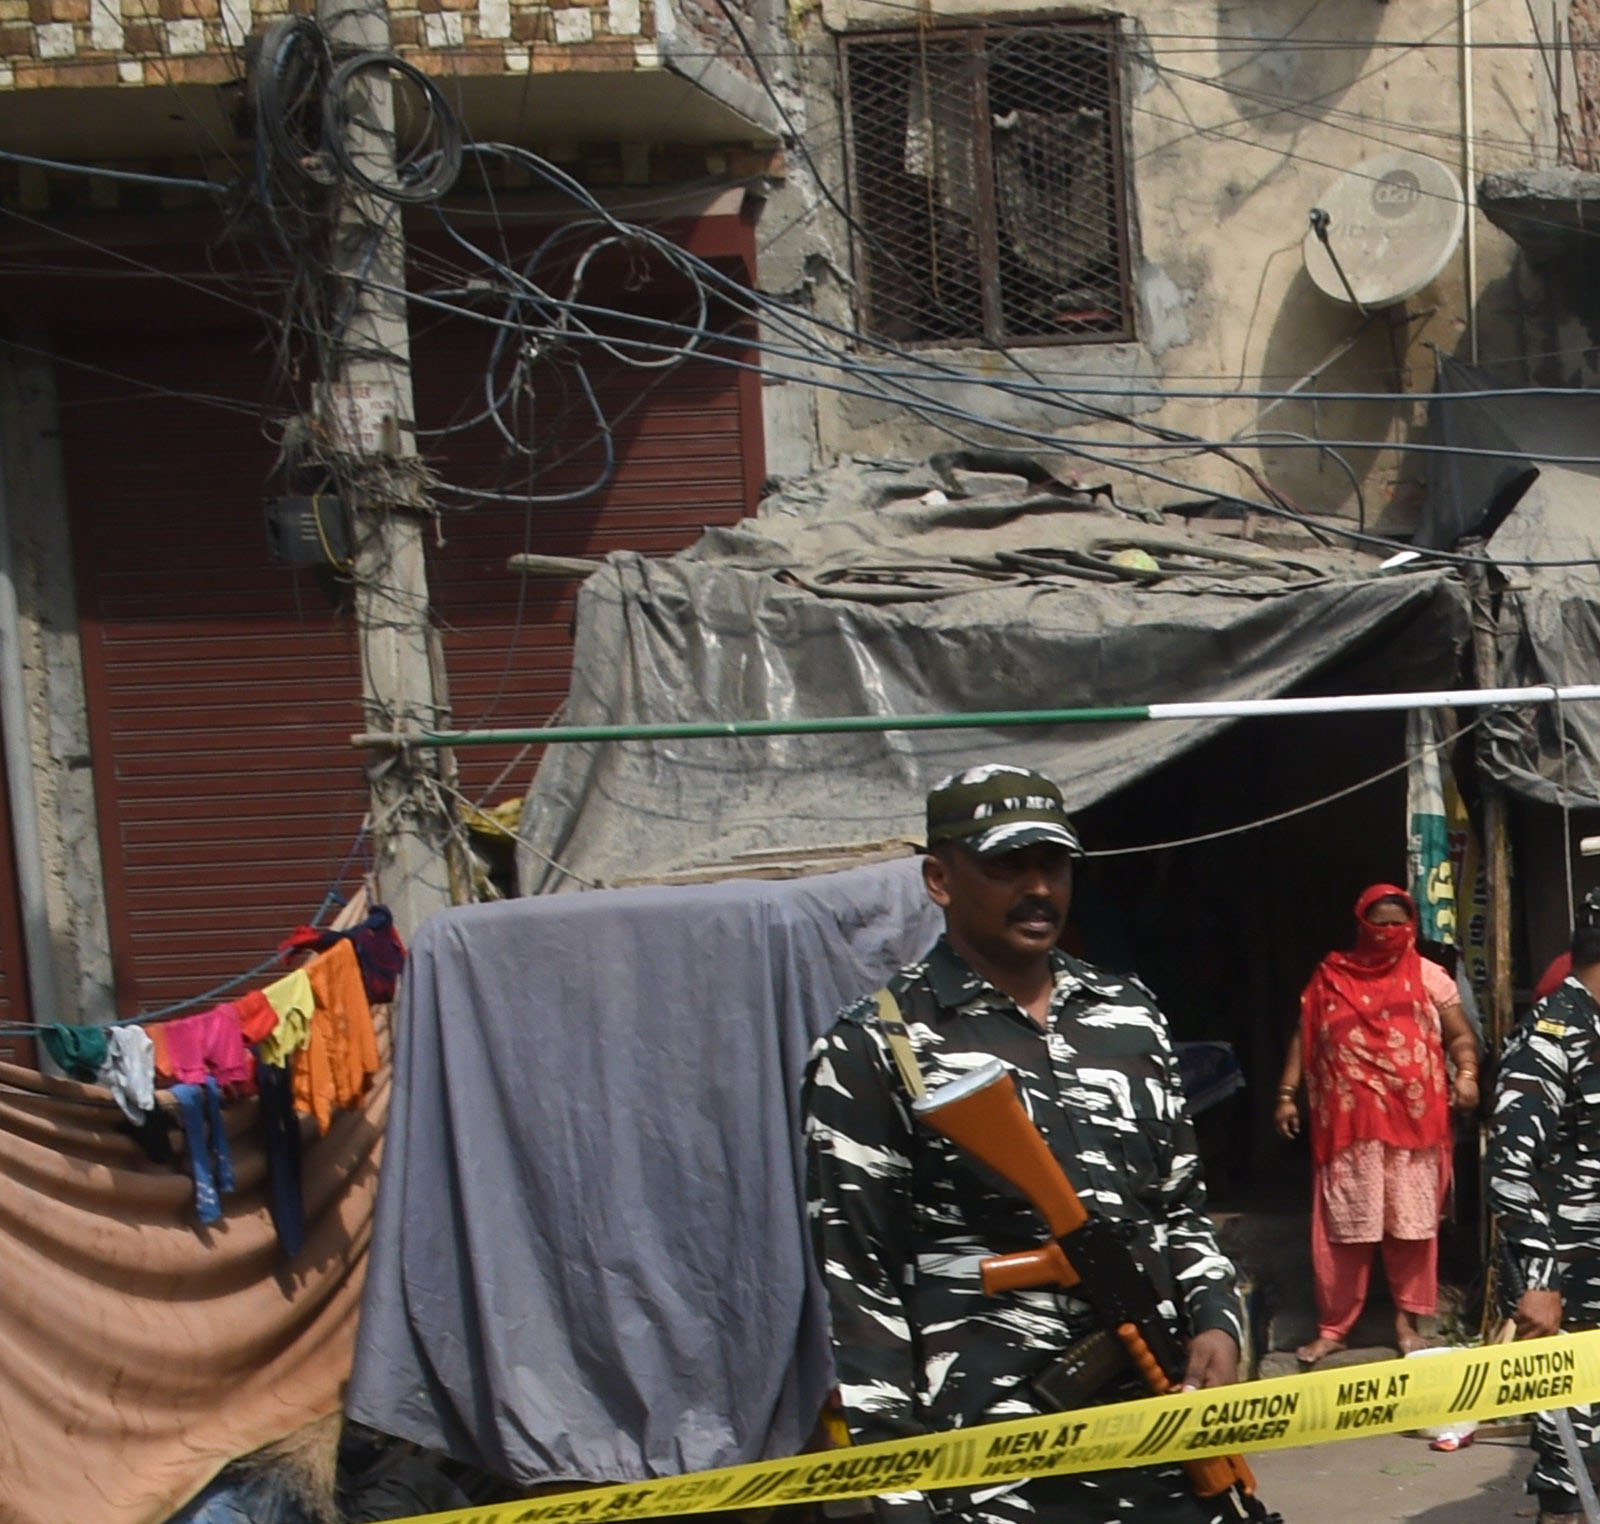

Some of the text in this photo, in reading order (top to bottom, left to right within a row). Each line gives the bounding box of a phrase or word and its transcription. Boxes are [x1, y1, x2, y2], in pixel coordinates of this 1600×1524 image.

[1500, 1349, 1575, 1381] CAUTION
[1337, 1374, 1410, 1407] MEN AT
[1496, 1375, 1574, 1406] DANGER
[1201, 1392, 1299, 1428] CAUTION
[1335, 1403, 1398, 1431] WORK
[986, 1423, 1087, 1458] MEN AT
[1186, 1419, 1290, 1449] DANGER
[806, 1447, 942, 1484] CAUTION
[513, 1499, 599, 1524] MEN
